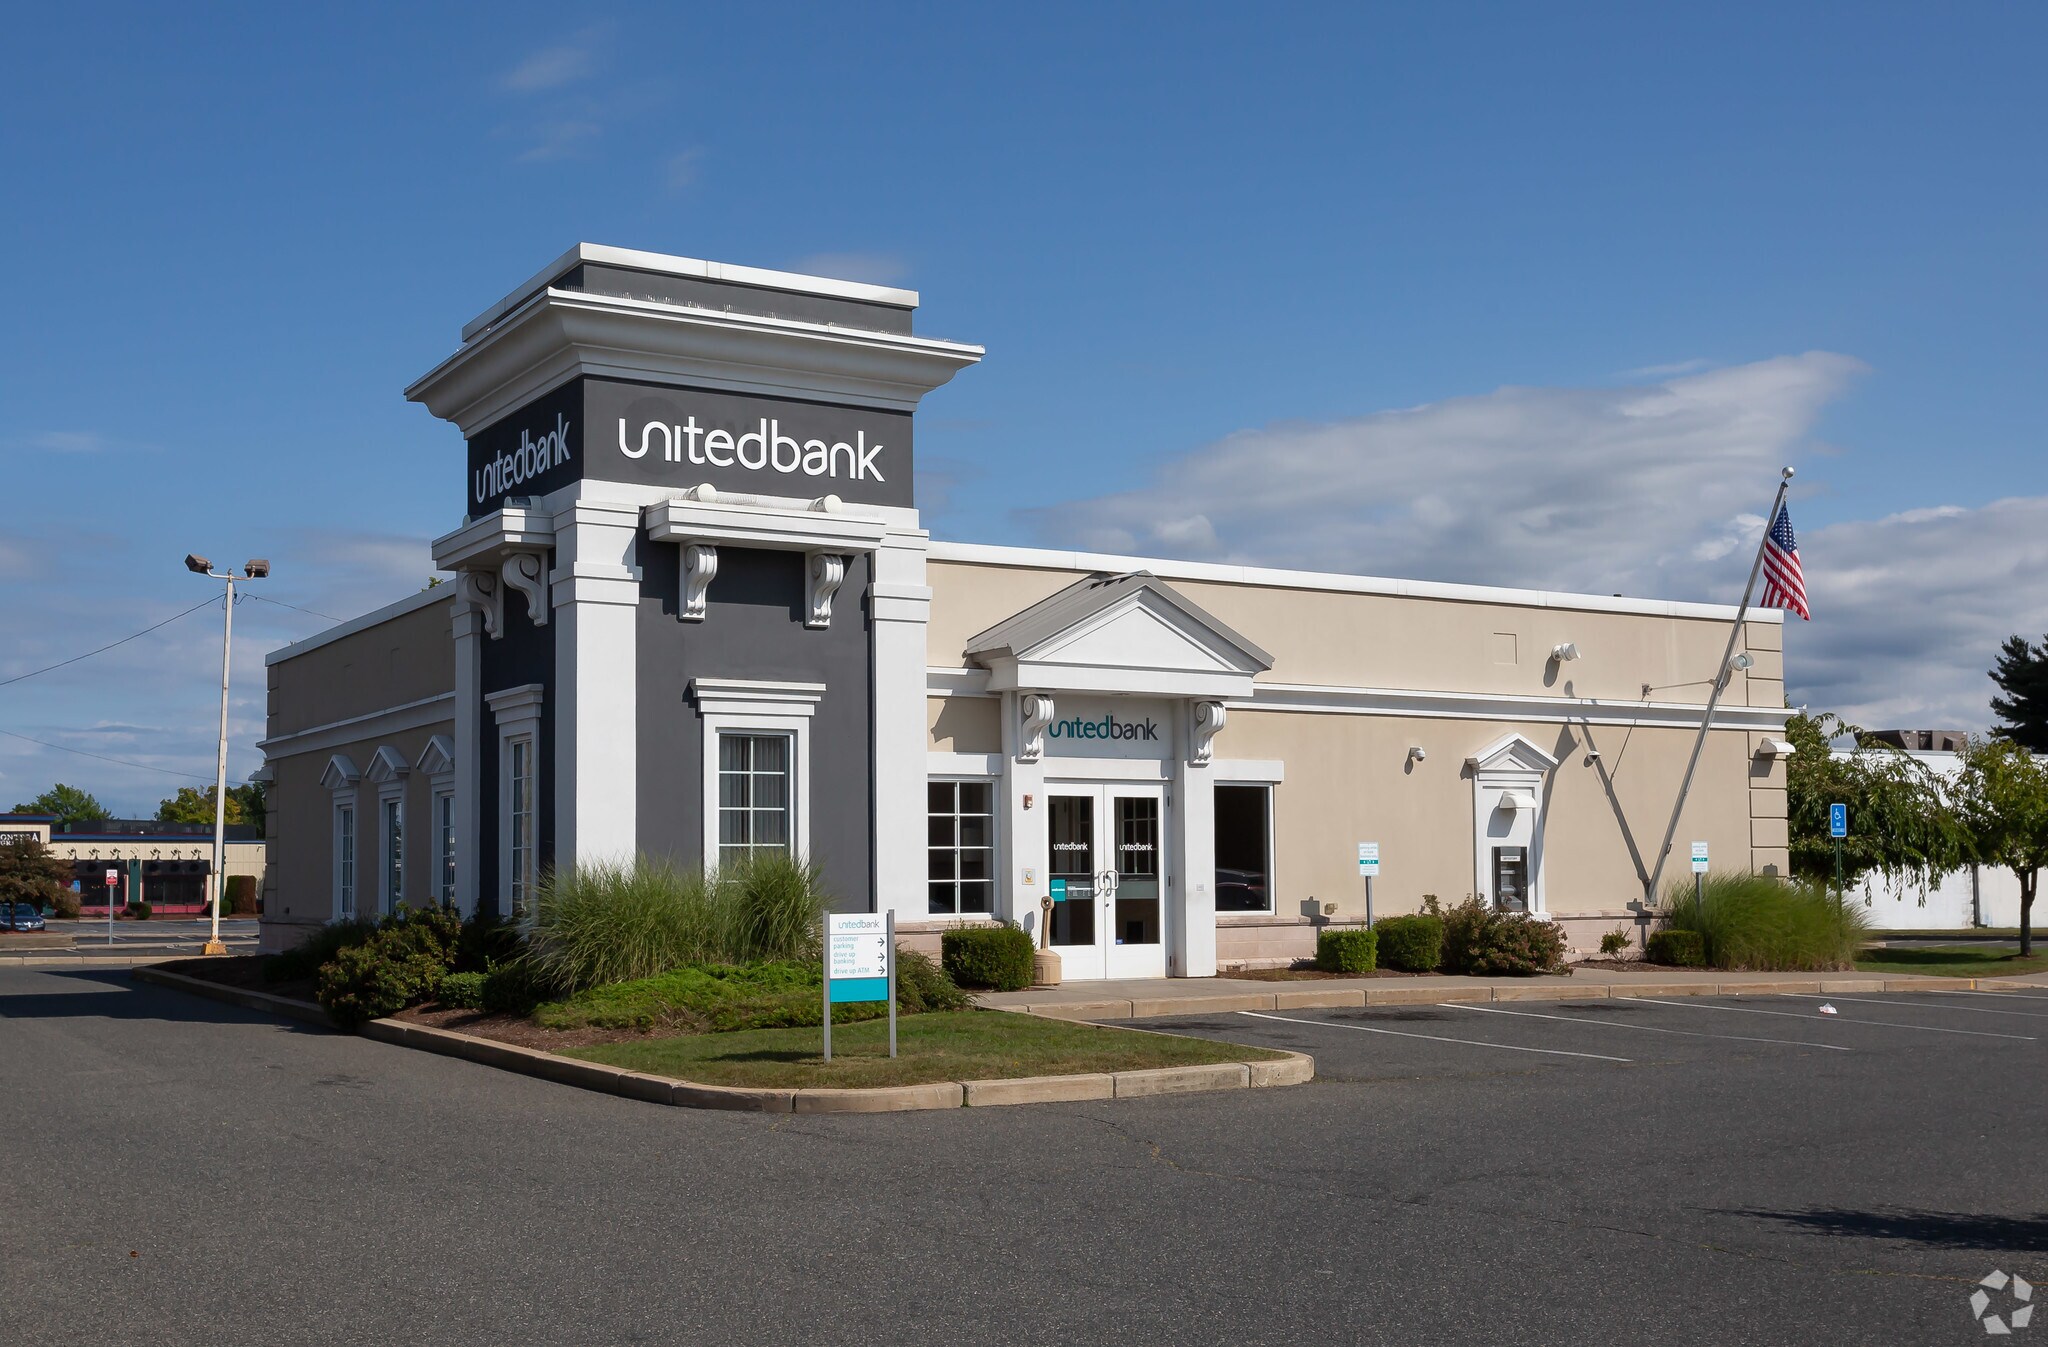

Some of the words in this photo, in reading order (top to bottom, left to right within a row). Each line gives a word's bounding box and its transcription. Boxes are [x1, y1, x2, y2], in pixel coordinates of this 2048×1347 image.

[476, 412, 571, 503] unitedbank
[618, 415, 886, 483] unitedbank
[1048, 715, 1158, 740] unitedbank
[1054, 842, 1088, 850] unitedbank
[1119, 842, 1153, 851] unitedbank
[838, 920, 880, 928] unitedbank
